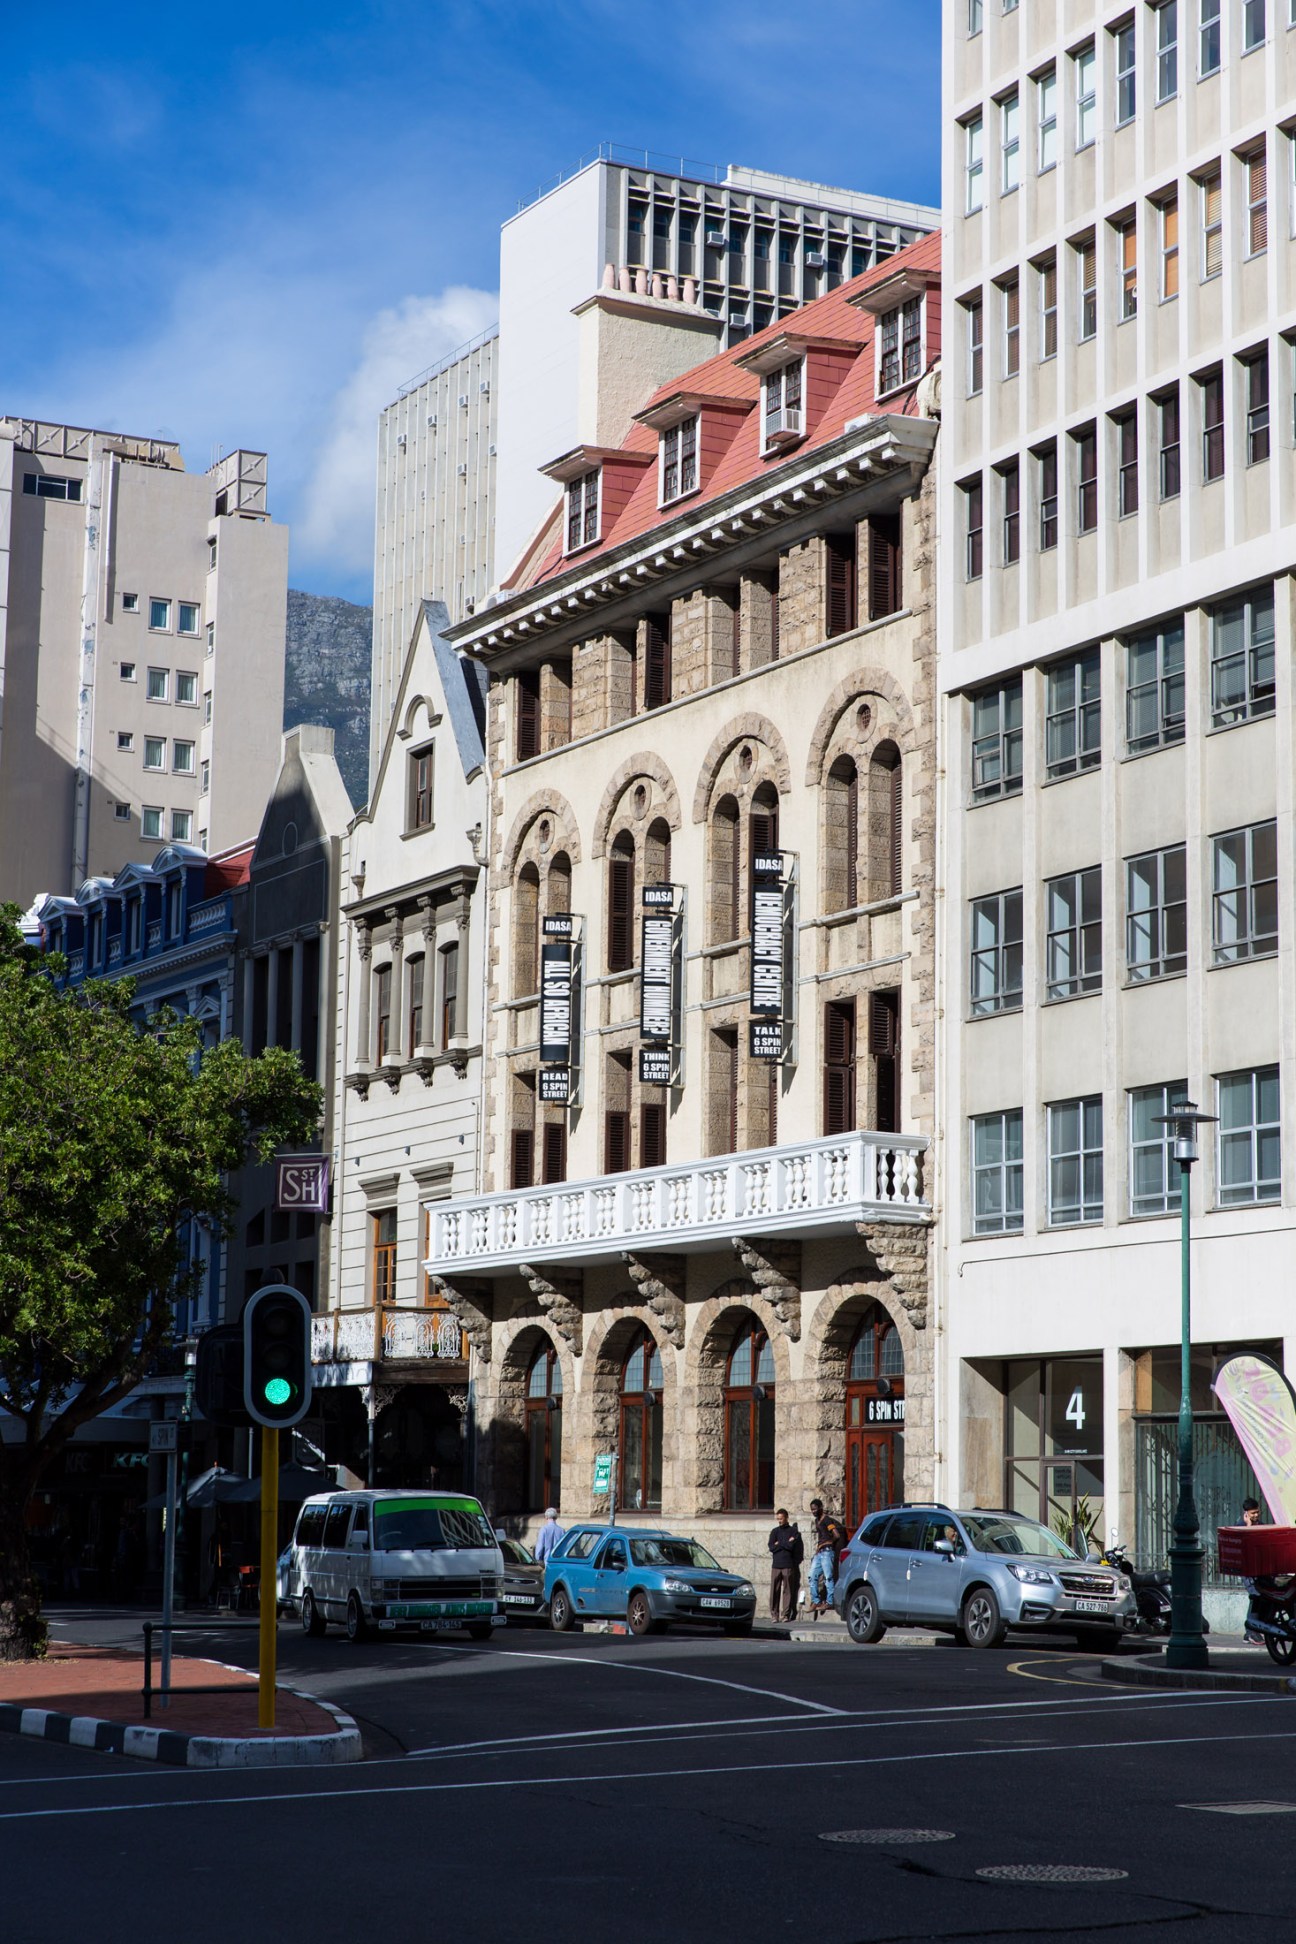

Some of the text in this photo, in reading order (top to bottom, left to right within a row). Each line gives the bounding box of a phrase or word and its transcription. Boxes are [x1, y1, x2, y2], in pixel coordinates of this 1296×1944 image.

[755, 858, 784, 870] IDASA
[645, 892, 673, 903] IDASA
[546, 920, 572, 931] IDASA
[644, 921, 672, 984] GOVERNMENT
[754, 892, 783, 1006] DEMOCRACY CENTRE
[543, 960, 570, 1045] ALL SO AFRICAN
[754, 1026, 781, 1035] TALK
[754, 1037, 781, 1046] 6 SPIN
[754, 1046, 781, 1054] STREET
[643, 1053, 669, 1061] THINK
[643, 1063, 669, 1071] 6 SPIN
[542, 1073, 568, 1081] READ
[643, 1071, 669, 1079] STREET
[542, 1083, 568, 1091] 6 SPIN
[868, 1400, 874, 1420] 6
[876, 1400, 892, 1420] SPIN
[1066, 1385, 1085, 1429] 4
[1078, 1601, 1084, 1609] CA
